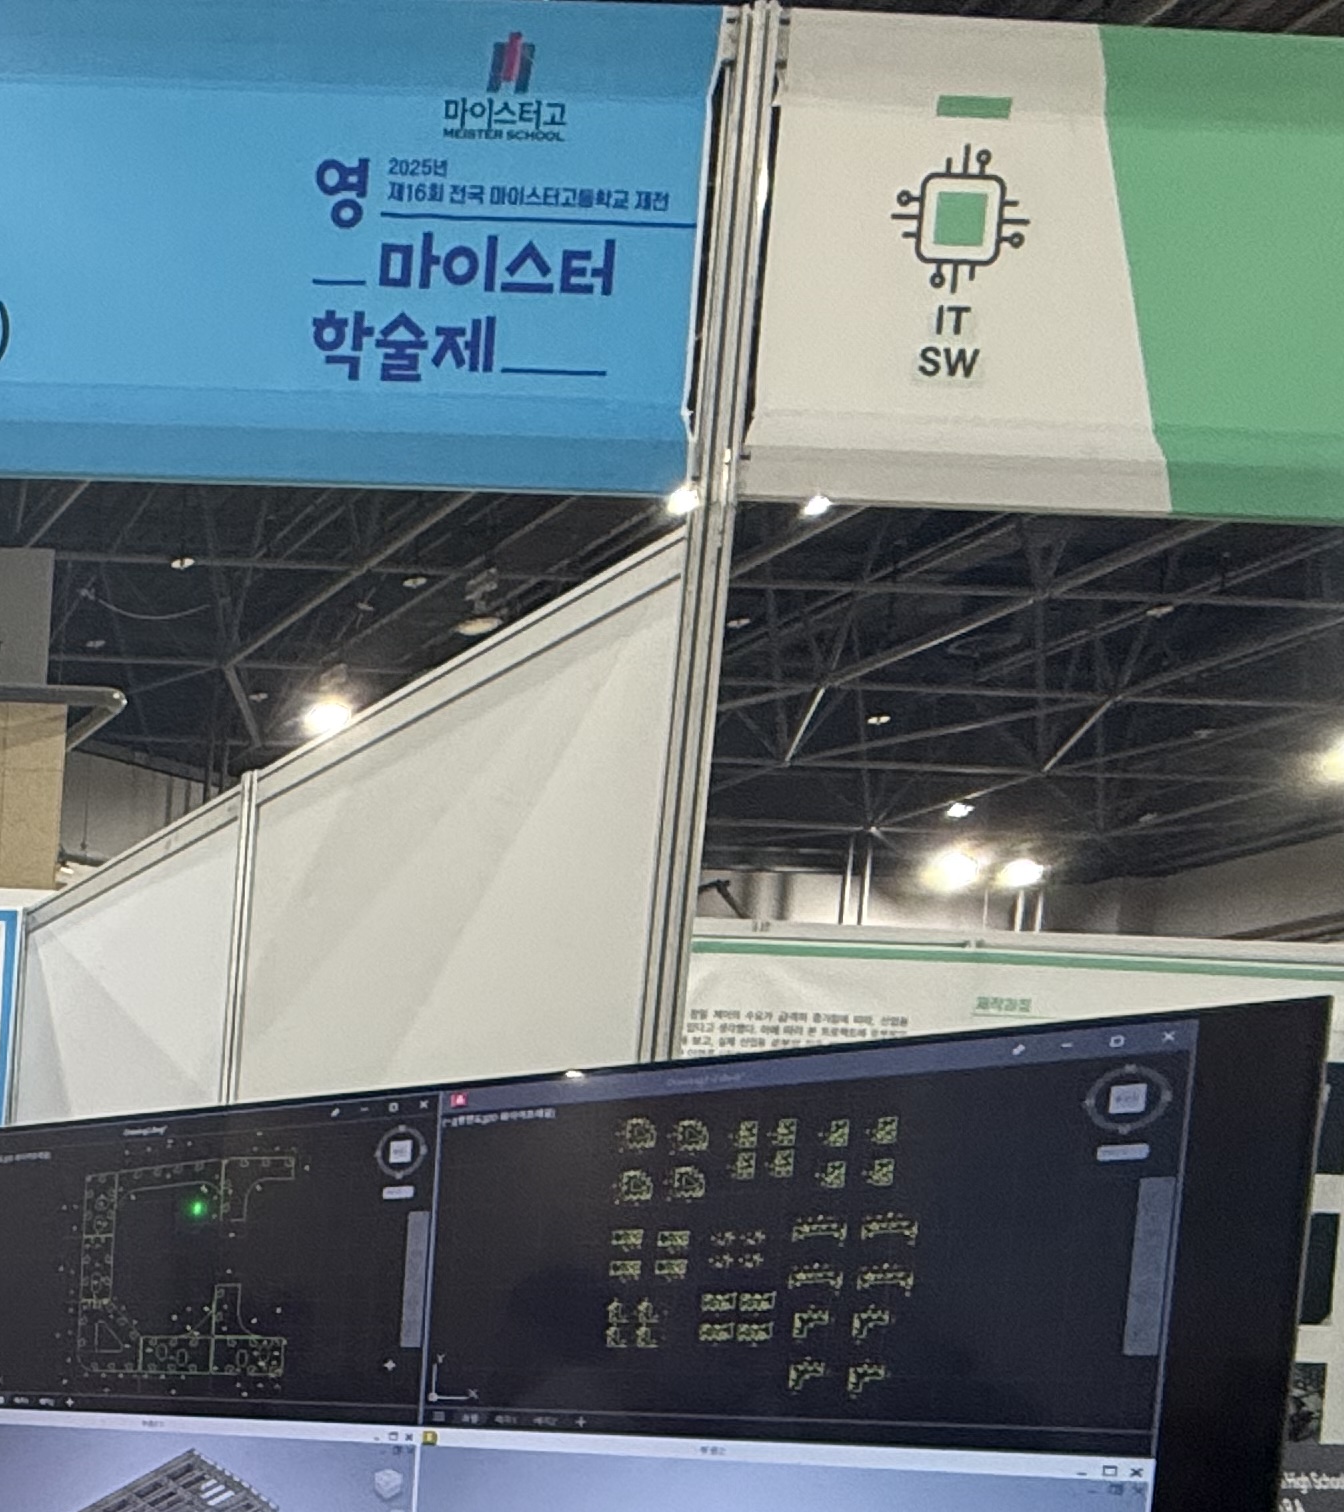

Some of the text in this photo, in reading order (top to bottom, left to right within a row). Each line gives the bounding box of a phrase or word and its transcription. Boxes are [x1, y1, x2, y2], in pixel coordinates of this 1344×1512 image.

[444, 98, 567, 129] 마이스터고
[443, 128, 564, 142] MEISTER SCHOOL
[388, 157, 447, 178] 2025년
[317, 158, 370, 228] 영
[388, 181, 444, 202] 제16회
[449, 183, 484, 205] 전국
[490, 187, 629, 209] 마이스터고등학교
[379, 232, 616, 296] 마이스터
[935, 305, 972, 336] IT
[312, 309, 496, 382] 학술제
[918, 347, 979, 380] SW
